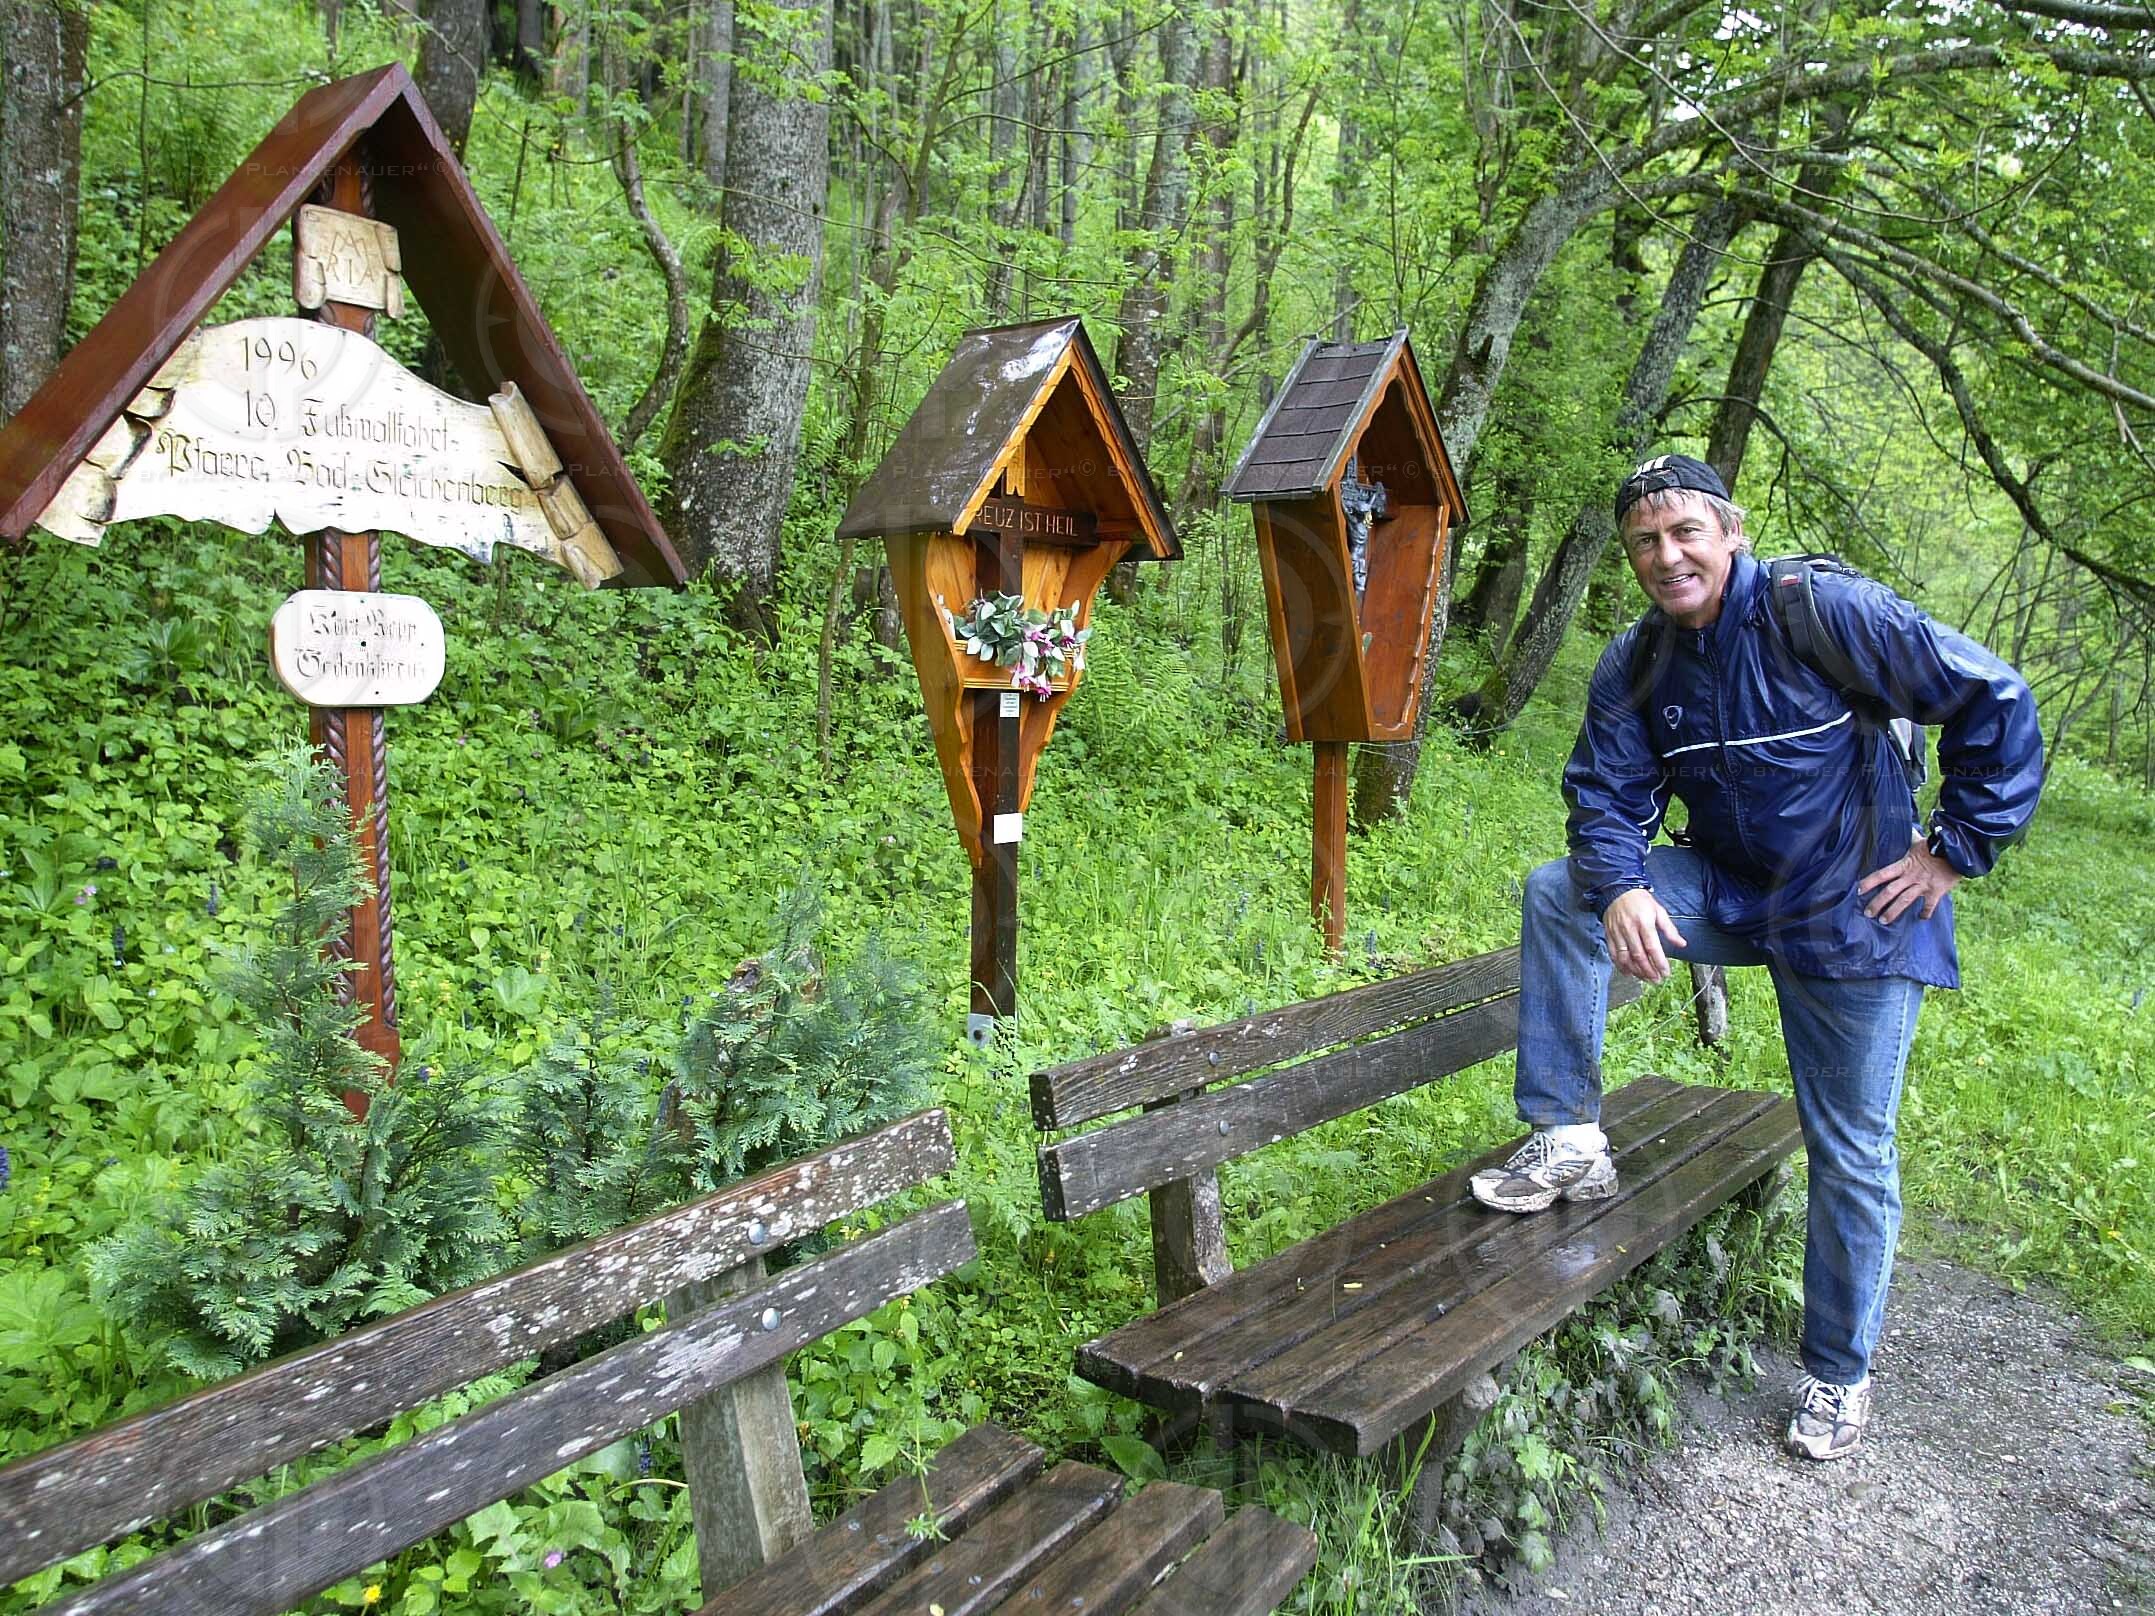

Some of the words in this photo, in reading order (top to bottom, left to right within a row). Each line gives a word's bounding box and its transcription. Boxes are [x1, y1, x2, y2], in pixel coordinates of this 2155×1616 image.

[242, 336, 317, 380] 1996
[1020, 510, 1042, 532] IST
[1045, 514, 1079, 536] HEIL
